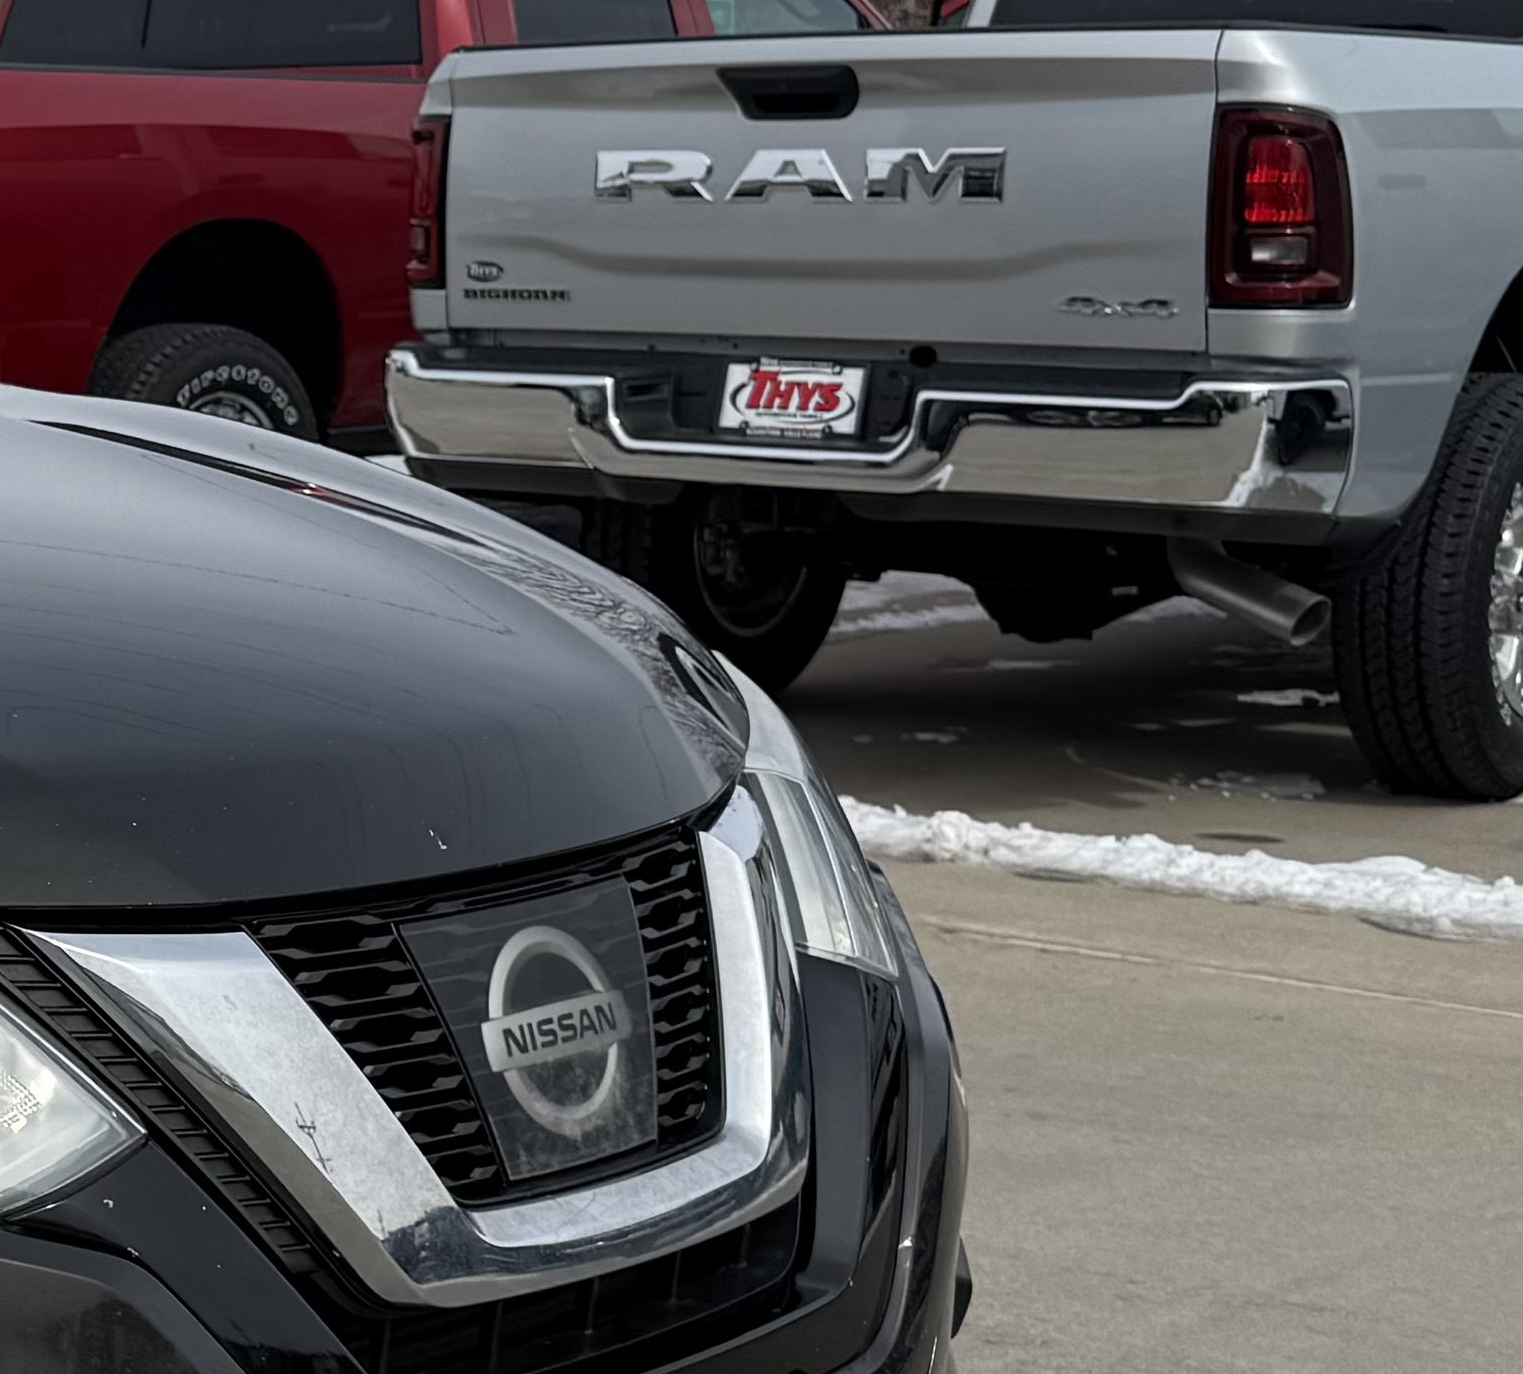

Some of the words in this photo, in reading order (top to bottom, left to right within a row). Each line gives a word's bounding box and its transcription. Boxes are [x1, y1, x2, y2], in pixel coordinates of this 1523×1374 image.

[593, 145, 1008, 204] RAM
[745, 370, 844, 413] THYS
[501, 1001, 618, 1059] NISSAN
